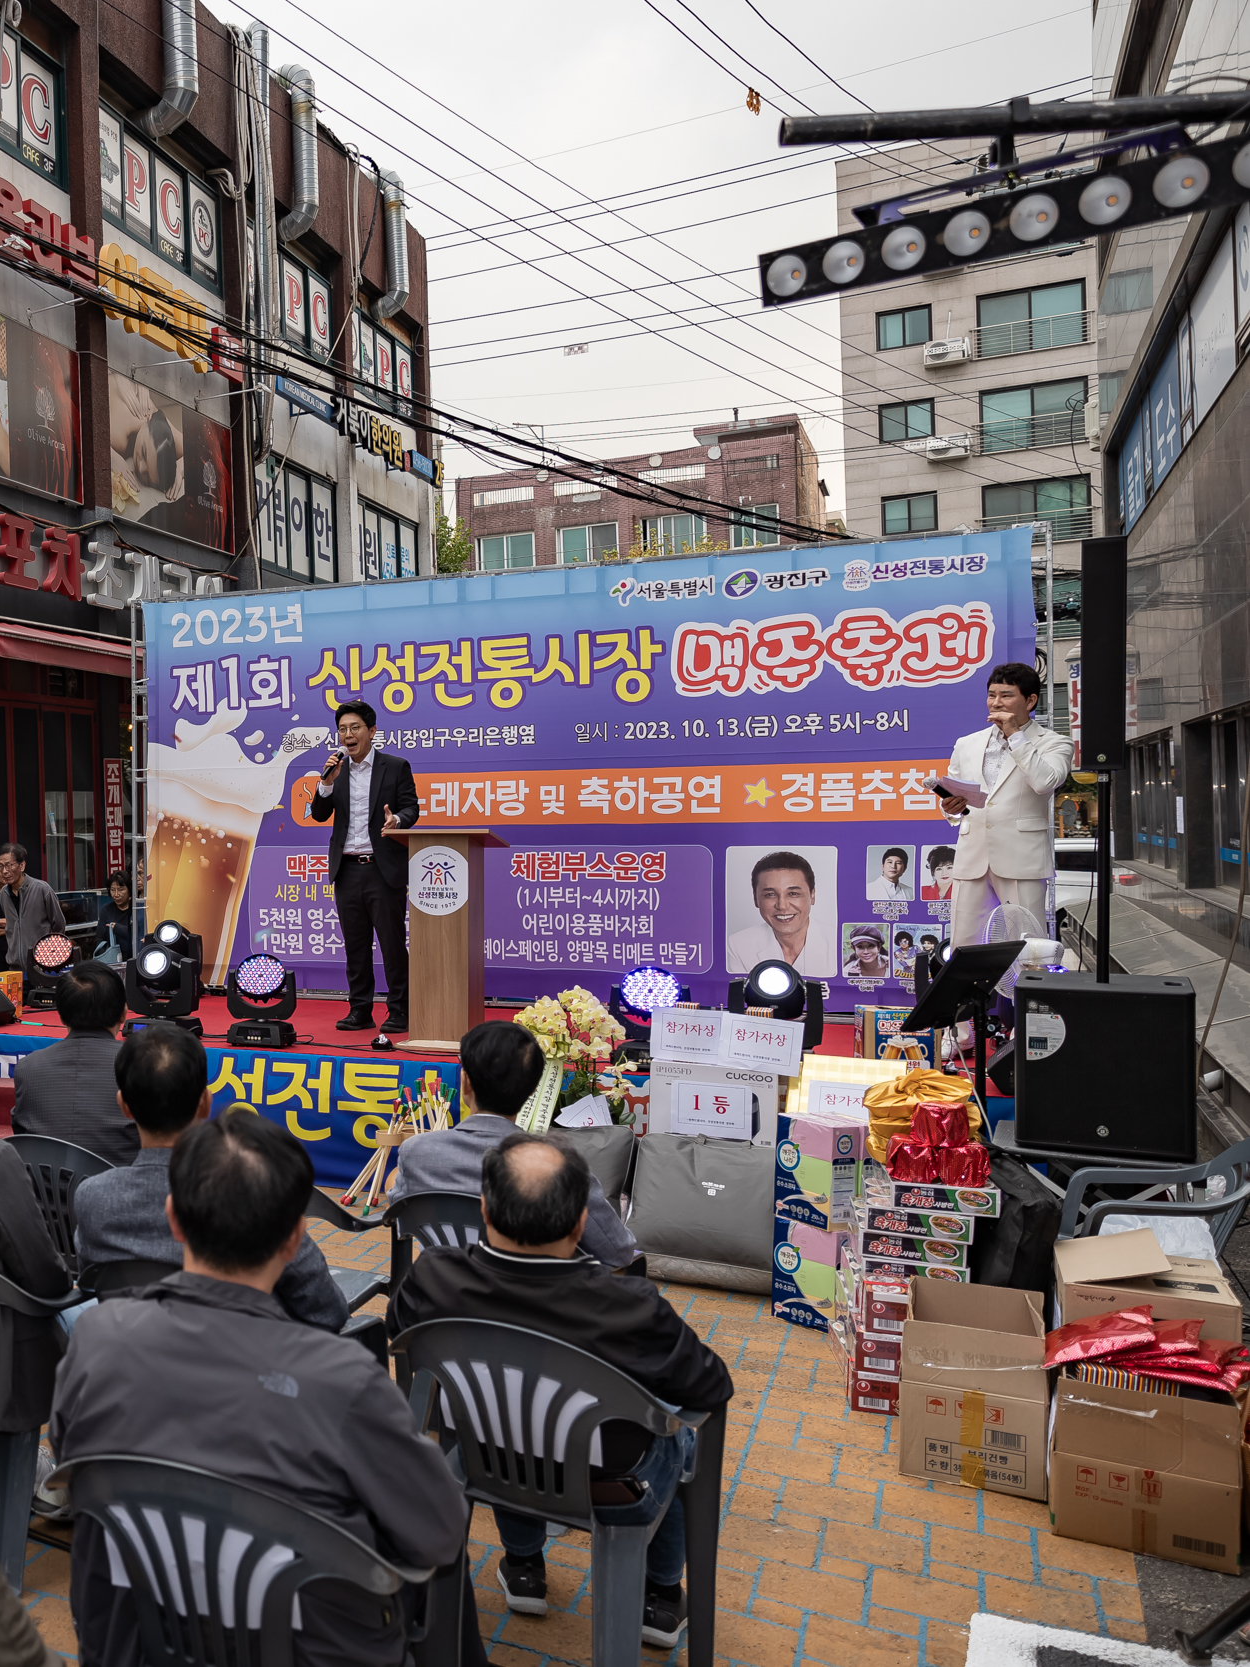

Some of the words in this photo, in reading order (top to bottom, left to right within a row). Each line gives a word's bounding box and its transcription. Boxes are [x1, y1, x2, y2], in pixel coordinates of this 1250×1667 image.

[22, 144, 40, 168] CAFE
[43, 157, 55, 174] 3F
[160, 239, 174, 259] CAFE
[175, 249, 184, 264] 3F
[284, 381, 299, 398] KOREAN
[299, 388, 315, 408] MEDICAL
[315, 398, 327, 415] CLINIC
[27, 428, 46, 445] Olive
[47, 437, 66, 452] Aroma
[434, 459, 445, 488] 2F
[197, 496, 210, 509] Olive
[210, 502, 224, 513] Aroma
[763, 567, 830, 590] 광진구
[871, 553, 987, 582] 신성전통시장
[636, 576, 714, 600] 서울특별시
[170, 603, 303, 648] 2023년
[172, 655, 292, 713] 제1회
[308, 628, 663, 713] 신성전통시장
[677, 608, 993, 694] 맥주축제
[281, 733, 312, 751] 장소
[324, 723, 536, 751] 신통시장입구우리은행옆
[575, 722, 610, 743] 일시
[624, 720, 676, 742] 2023.
[682, 718, 706, 739] 10.
[783, 714, 823, 736] 오후
[829, 709, 910, 734] 5시~8시
[539, 785, 565, 816] 및
[577, 774, 722, 814] 축하공연
[780, 769, 937, 812] 경품추첨
[286, 854, 330, 882] 맥주
[510, 851, 666, 883] 체험부스운영
[274, 883, 300, 902] 시장
[306, 883, 317, 902] 내
[322, 883, 335, 902] 맥
[418, 891, 458, 900] 신성전통시장
[516, 886, 661, 911] (1시부터~4시까지)
[419, 900, 438, 909] SINCE
[441, 901, 456, 909] 1972
[259, 908, 303, 930] 5천원
[307, 908, 340, 930] 영수
[521, 914, 654, 938] 어린이용품바자회
[261, 932, 303, 955] 1만원
[308, 933, 345, 955] 영수
[567, 938, 609, 964] 양말목
[613, 942, 656, 966] 티메트
[659, 943, 703, 967] 만들기
[666, 1021, 716, 1037] 참가자상
[735, 1028, 788, 1047] 참가자상
[725, 1072, 773, 1083] CUCKOO
[712, 1095, 731, 1114] 등
[824, 1094, 863, 1108] 참가자
[901, 1192, 934, 1208] 육개장
[933, 1201, 955, 1209] 사발면
[874, 1215, 908, 1232] 육개장
[906, 1226, 928, 1234] 사발면
[869, 1240, 902, 1257] 육개장
[900, 1251, 922, 1259] 사발면
[968, 1449, 1009, 1465] 보리건빵
[1100, 1496, 1124, 1507] months
